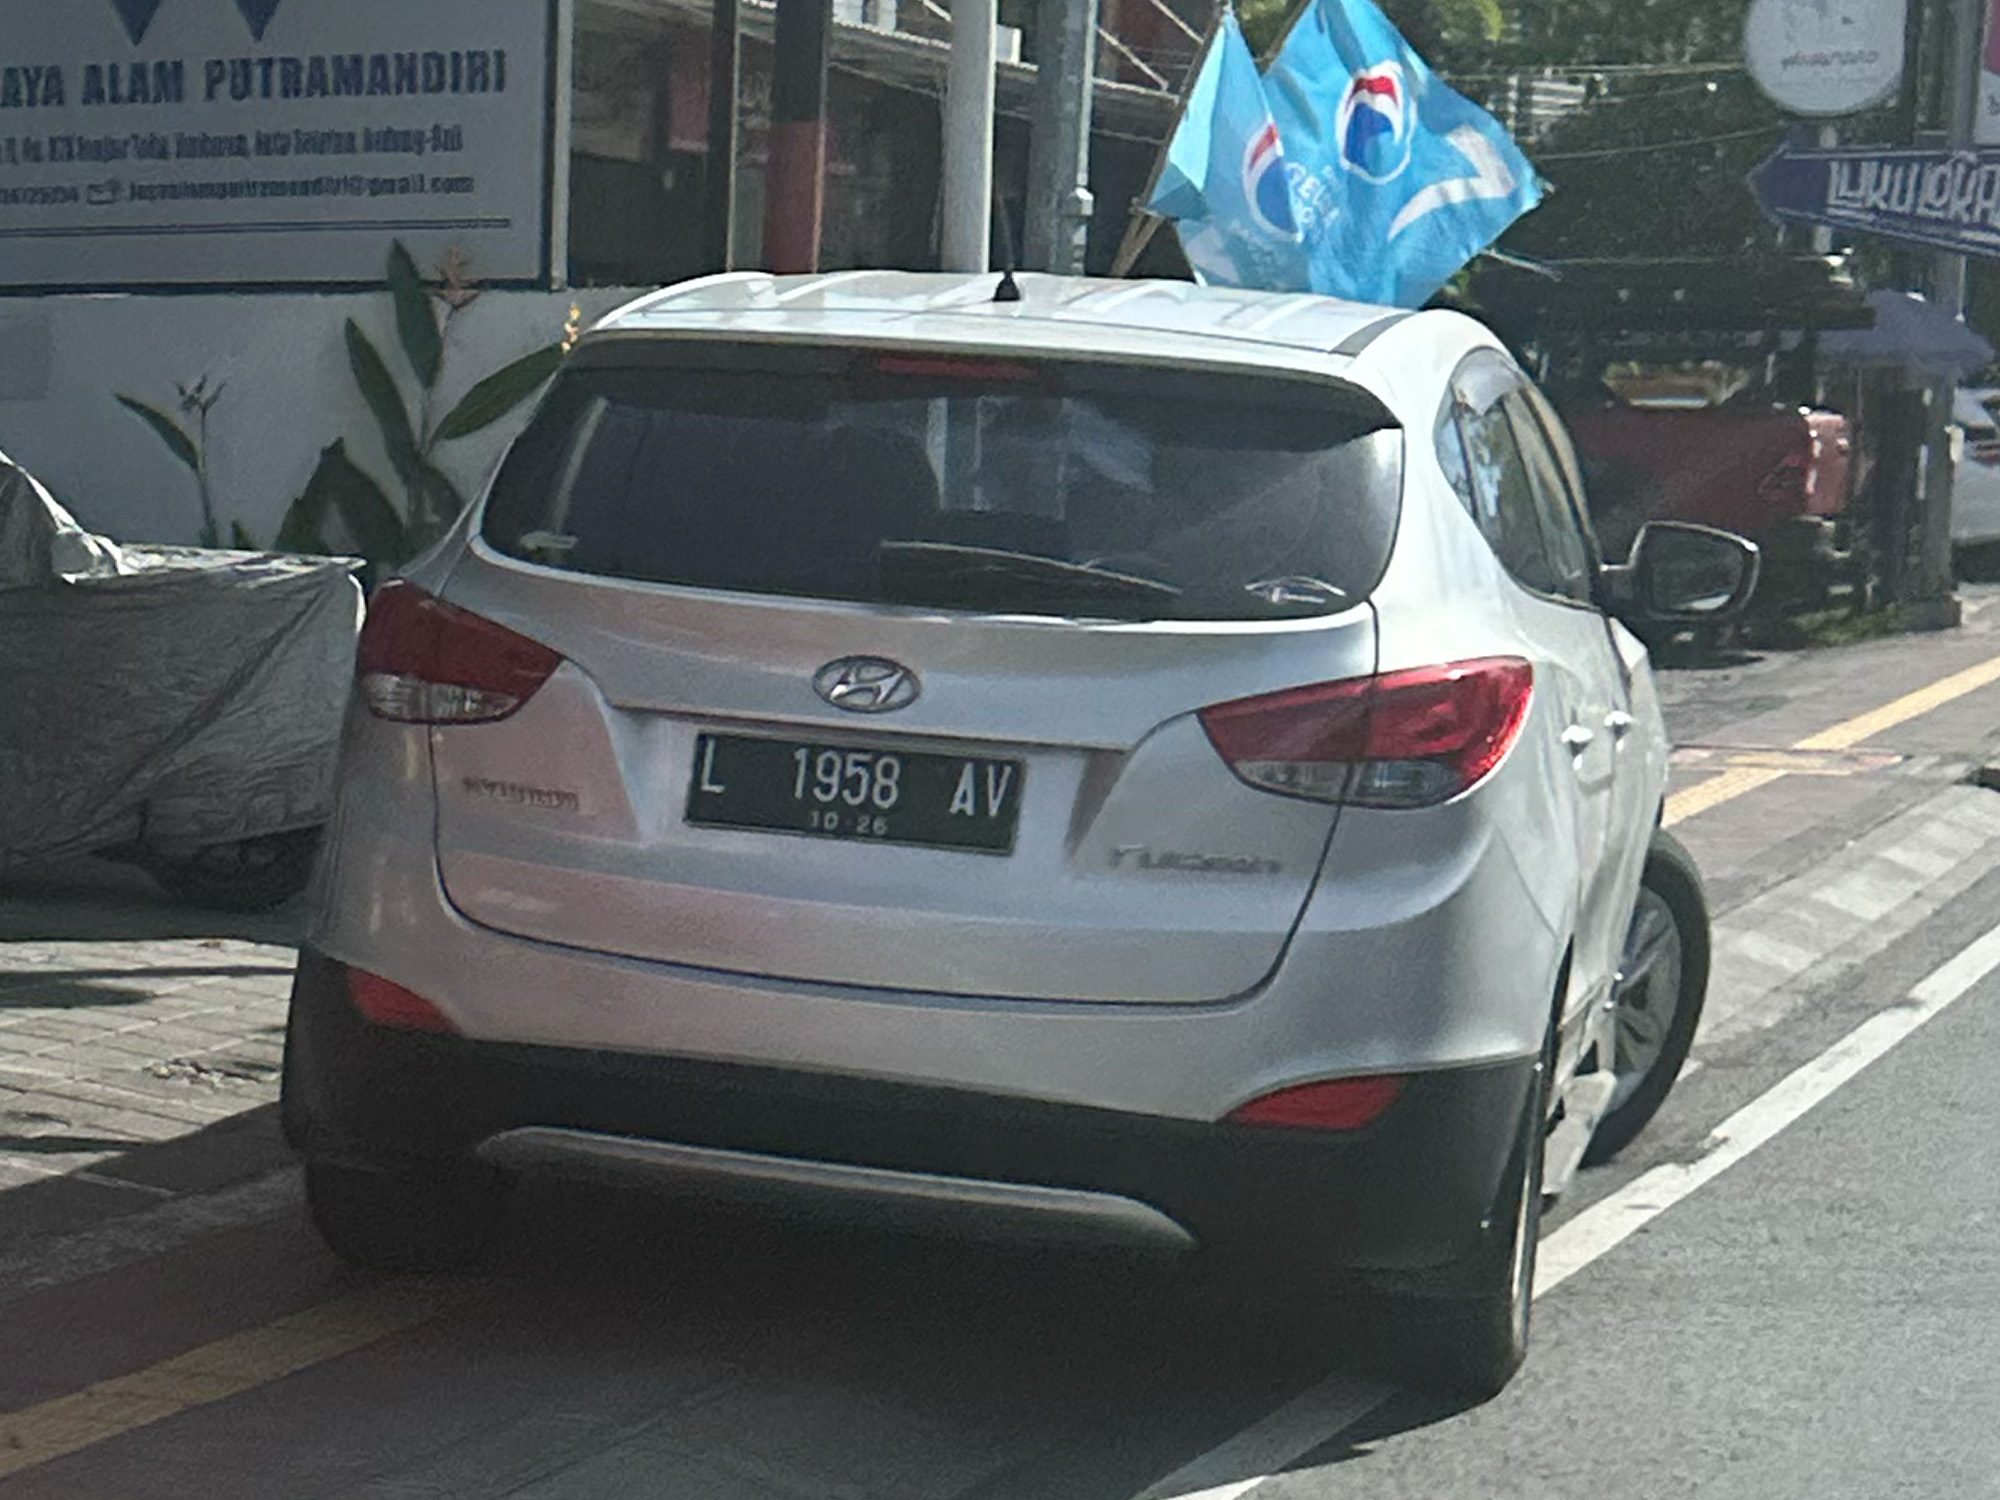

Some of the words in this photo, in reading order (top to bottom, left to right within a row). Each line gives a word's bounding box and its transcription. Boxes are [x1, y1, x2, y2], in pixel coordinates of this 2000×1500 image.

[81, 60, 184, 104] ALAM
[203, 49, 507, 102] PUTRAMANDIRI
[701, 738, 726, 794] L
[793, 748, 901, 810] 1958
[949, 761, 1012, 817] AV
[811, 810, 839, 831] 10
[856, 815, 889, 836] 26
